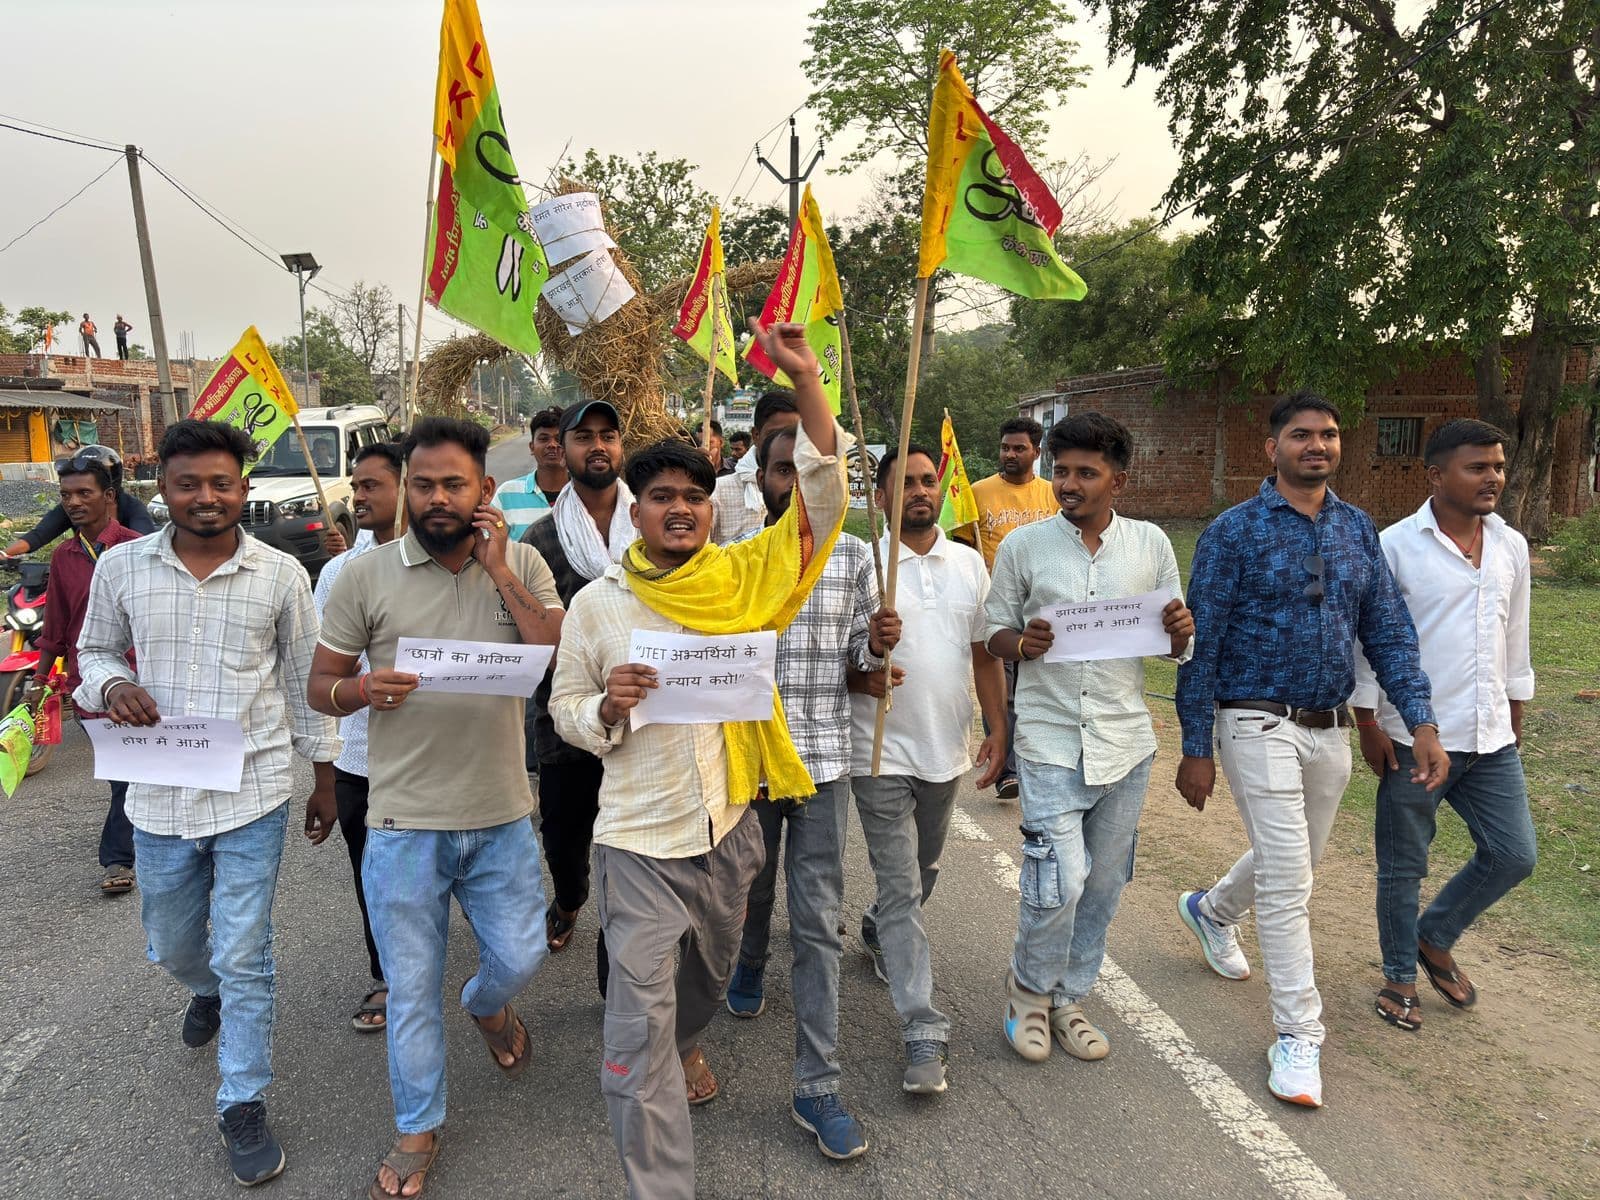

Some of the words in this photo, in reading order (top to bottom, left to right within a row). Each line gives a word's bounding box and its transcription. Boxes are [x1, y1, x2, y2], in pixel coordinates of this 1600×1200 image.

[573, 264, 595, 282] सरकार
[1104, 603, 1142, 612] सरकार
[1066, 622, 1087, 632] होश
[1094, 619, 1104, 628] में
[1111, 617, 1141, 627] आओ
[451, 652, 470, 663] का
[477, 653, 524, 664] भविष्य
[670, 645, 736, 661] अभ्यर्थियों
[744, 644, 757, 657] के
[666, 677, 701, 686] न्याय
[122, 737, 147, 746] होश
[155, 735, 168, 746] में
[176, 738, 210, 748] आओ
